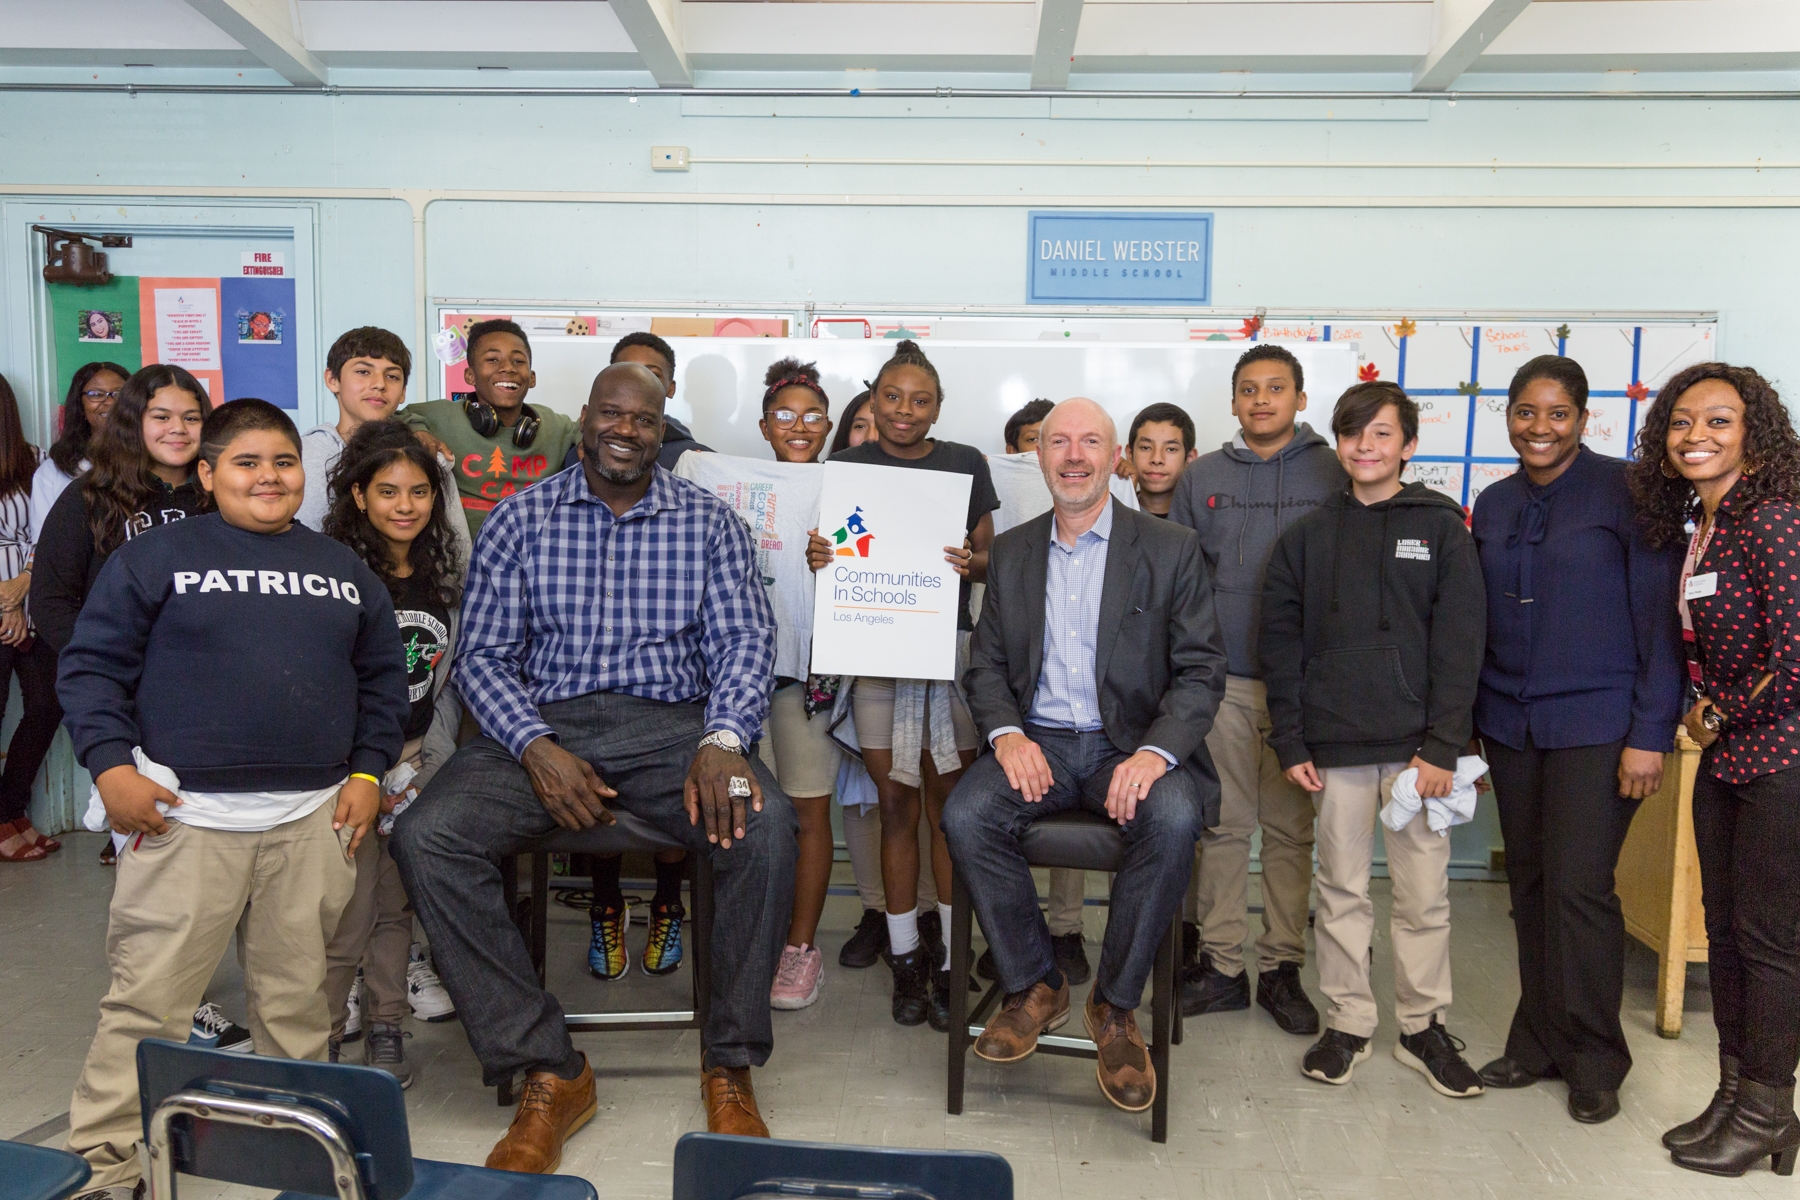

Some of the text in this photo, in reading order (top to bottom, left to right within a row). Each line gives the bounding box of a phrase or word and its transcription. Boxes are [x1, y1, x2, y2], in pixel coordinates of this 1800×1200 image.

[254, 253, 272, 262] FIRE
[1041, 239, 1200, 262] DANIEL WEBSTER
[243, 265, 284, 275] EXTINGUISHER
[1050, 268, 1182, 278] MIDDLE SCHOOL
[1263, 327, 1318, 339] Birthdays
[1333, 330, 1363, 340] Coffee
[1412, 464, 1451, 476] PSAT
[750, 483, 773, 491] CAREER
[749, 492, 757, 510] SUCCESS
[1207, 493, 1319, 517] Champion
[755, 492, 767, 530] GOALS
[765, 493, 777, 532] FUTURE
[761, 539, 783, 550] DREAM
[835, 566, 941, 588] Communities
[173, 570, 361, 605] PATRICIO
[834, 585, 917, 605] In Schools
[833, 611, 894, 625] Los Angeles
[427, 617, 448, 642] SCHOOL
